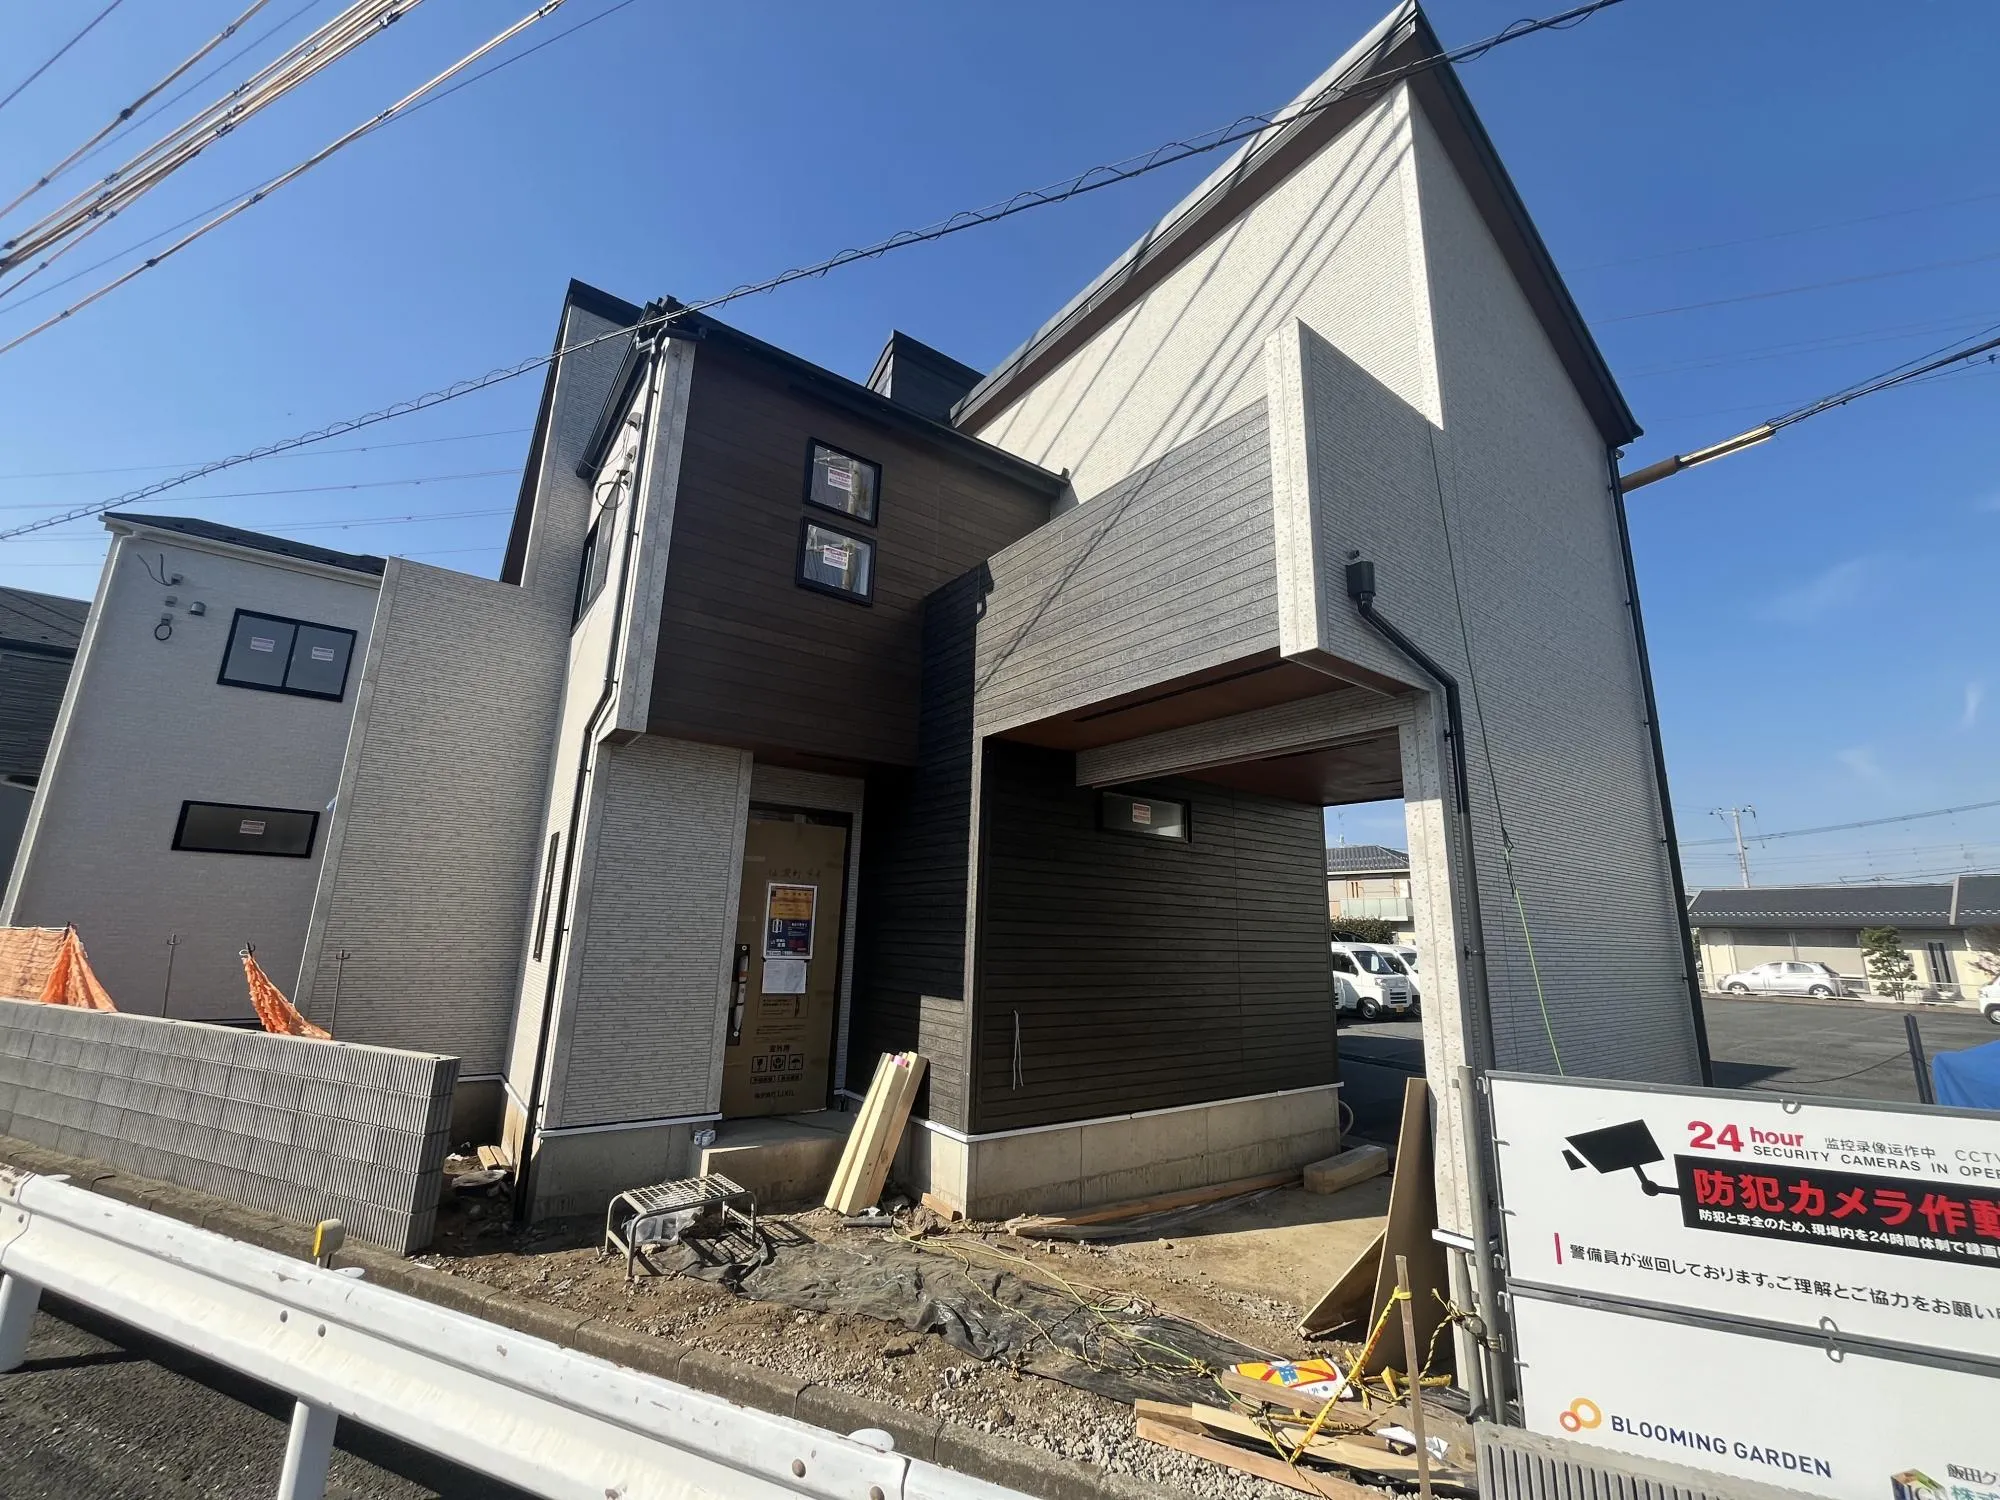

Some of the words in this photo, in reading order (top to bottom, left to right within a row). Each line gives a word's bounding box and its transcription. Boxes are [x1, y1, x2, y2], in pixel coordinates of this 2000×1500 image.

[1687, 1120, 1745, 1153] 24
[1749, 1126, 1804, 1147] hour
[1753, 1145, 1830, 1162] SECURITY
[1840, 1154, 1921, 1172] CAMERAS
[1931, 1162, 1948, 1174] IN
[1824, 1137, 1936, 1159] 监控录像运作中
[1692, 1168, 2000, 1240] 防犯カメラ作動
[1698, 1208, 2000, 1259] 防犯と安全のため、現場内を24時間体制で録画
[1569, 1243, 2000, 1320] 警備員が巡回しております。ご理解とご協力をお願い
[1610, 1414, 1728, 1456] BLOOMING
[1733, 1441, 1833, 1480] GARDEN
